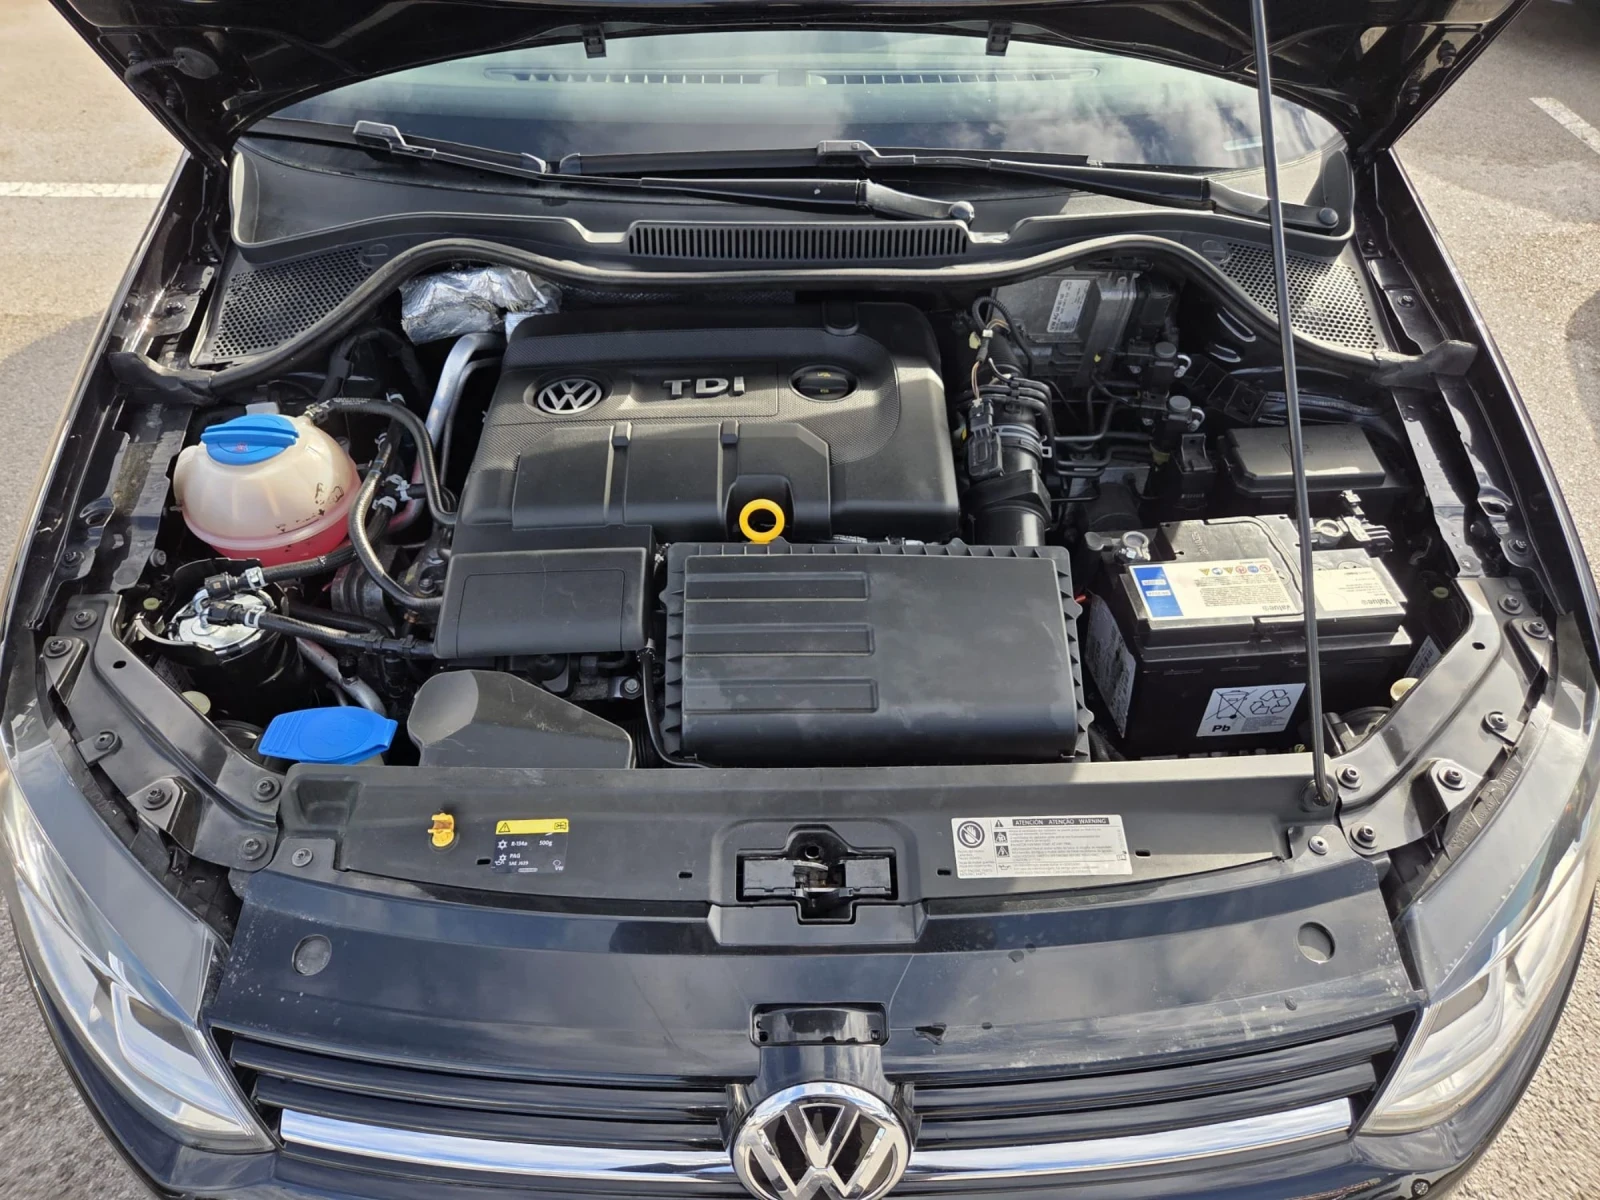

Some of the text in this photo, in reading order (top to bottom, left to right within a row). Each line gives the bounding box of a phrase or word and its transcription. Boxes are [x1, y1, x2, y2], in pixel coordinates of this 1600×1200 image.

[537, 378, 602, 415] VW
[663, 375, 745, 397] TDI
[1211, 724, 1231, 732] Pb
